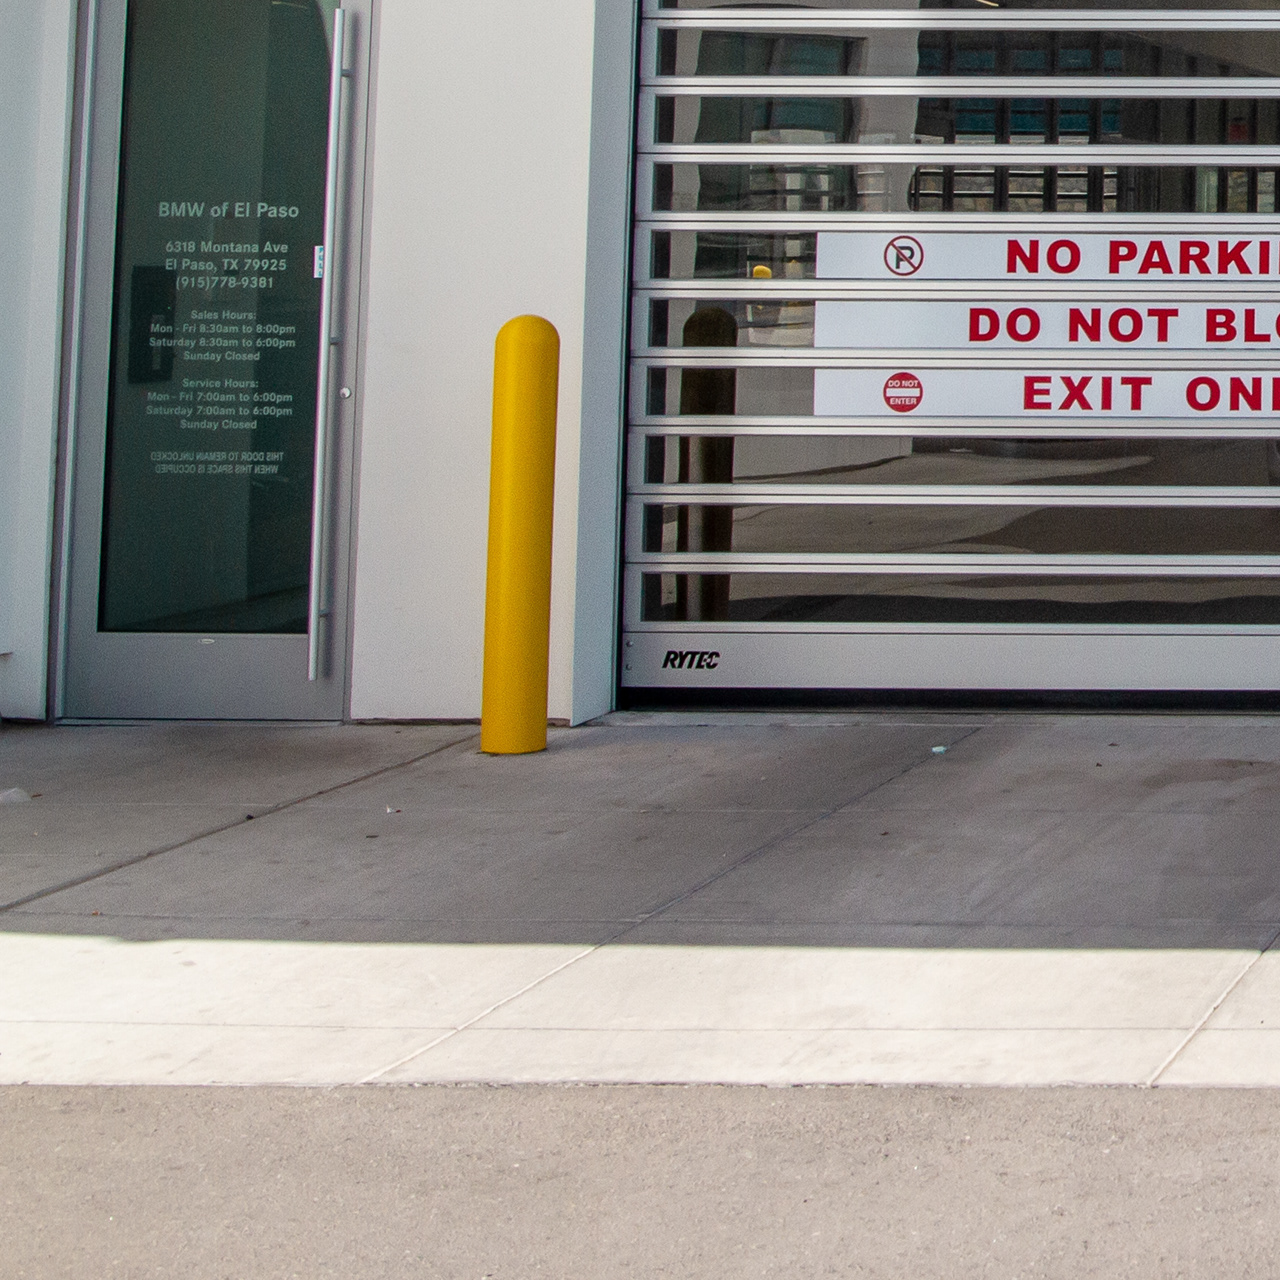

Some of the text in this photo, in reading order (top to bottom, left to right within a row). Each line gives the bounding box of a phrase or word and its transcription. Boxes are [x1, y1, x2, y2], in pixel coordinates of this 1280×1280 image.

[158, 202, 299, 218] BMW of El Paso
[165, 242, 288, 253] 6318 Montana Ave
[1008, 240, 1081, 274] NO
[165, 259, 177, 271] El
[222, 259, 239, 271] TX
[243, 259, 287, 271] 79925
[175, 277, 273, 291] (915)778-9381
[191, 310, 218, 320] Sales
[150, 323, 173, 333] Mon
[182, 323, 196, 333] Fri
[242, 324, 252, 334] to
[970, 308, 1040, 341] DO
[1070, 308, 1178, 342] NOT
[149, 337, 196, 349] Saturday
[242, 338, 252, 347] to
[183, 351, 260, 362] Sunday Closed
[182, 378, 221, 388] Service
[888, 380, 900, 388] DO
[147, 392, 170, 402] Mon
[179, 392, 194, 402] Fri
[239, 392, 250, 402] to
[1024, 376, 1152, 410] EXIT
[889, 397, 917, 405] ENTER
[146, 406, 193, 417] Saturday
[239, 406, 250, 416] to
[180, 419, 257, 431] Sunday Closed
[662, 651, 720, 669] RYTEC
